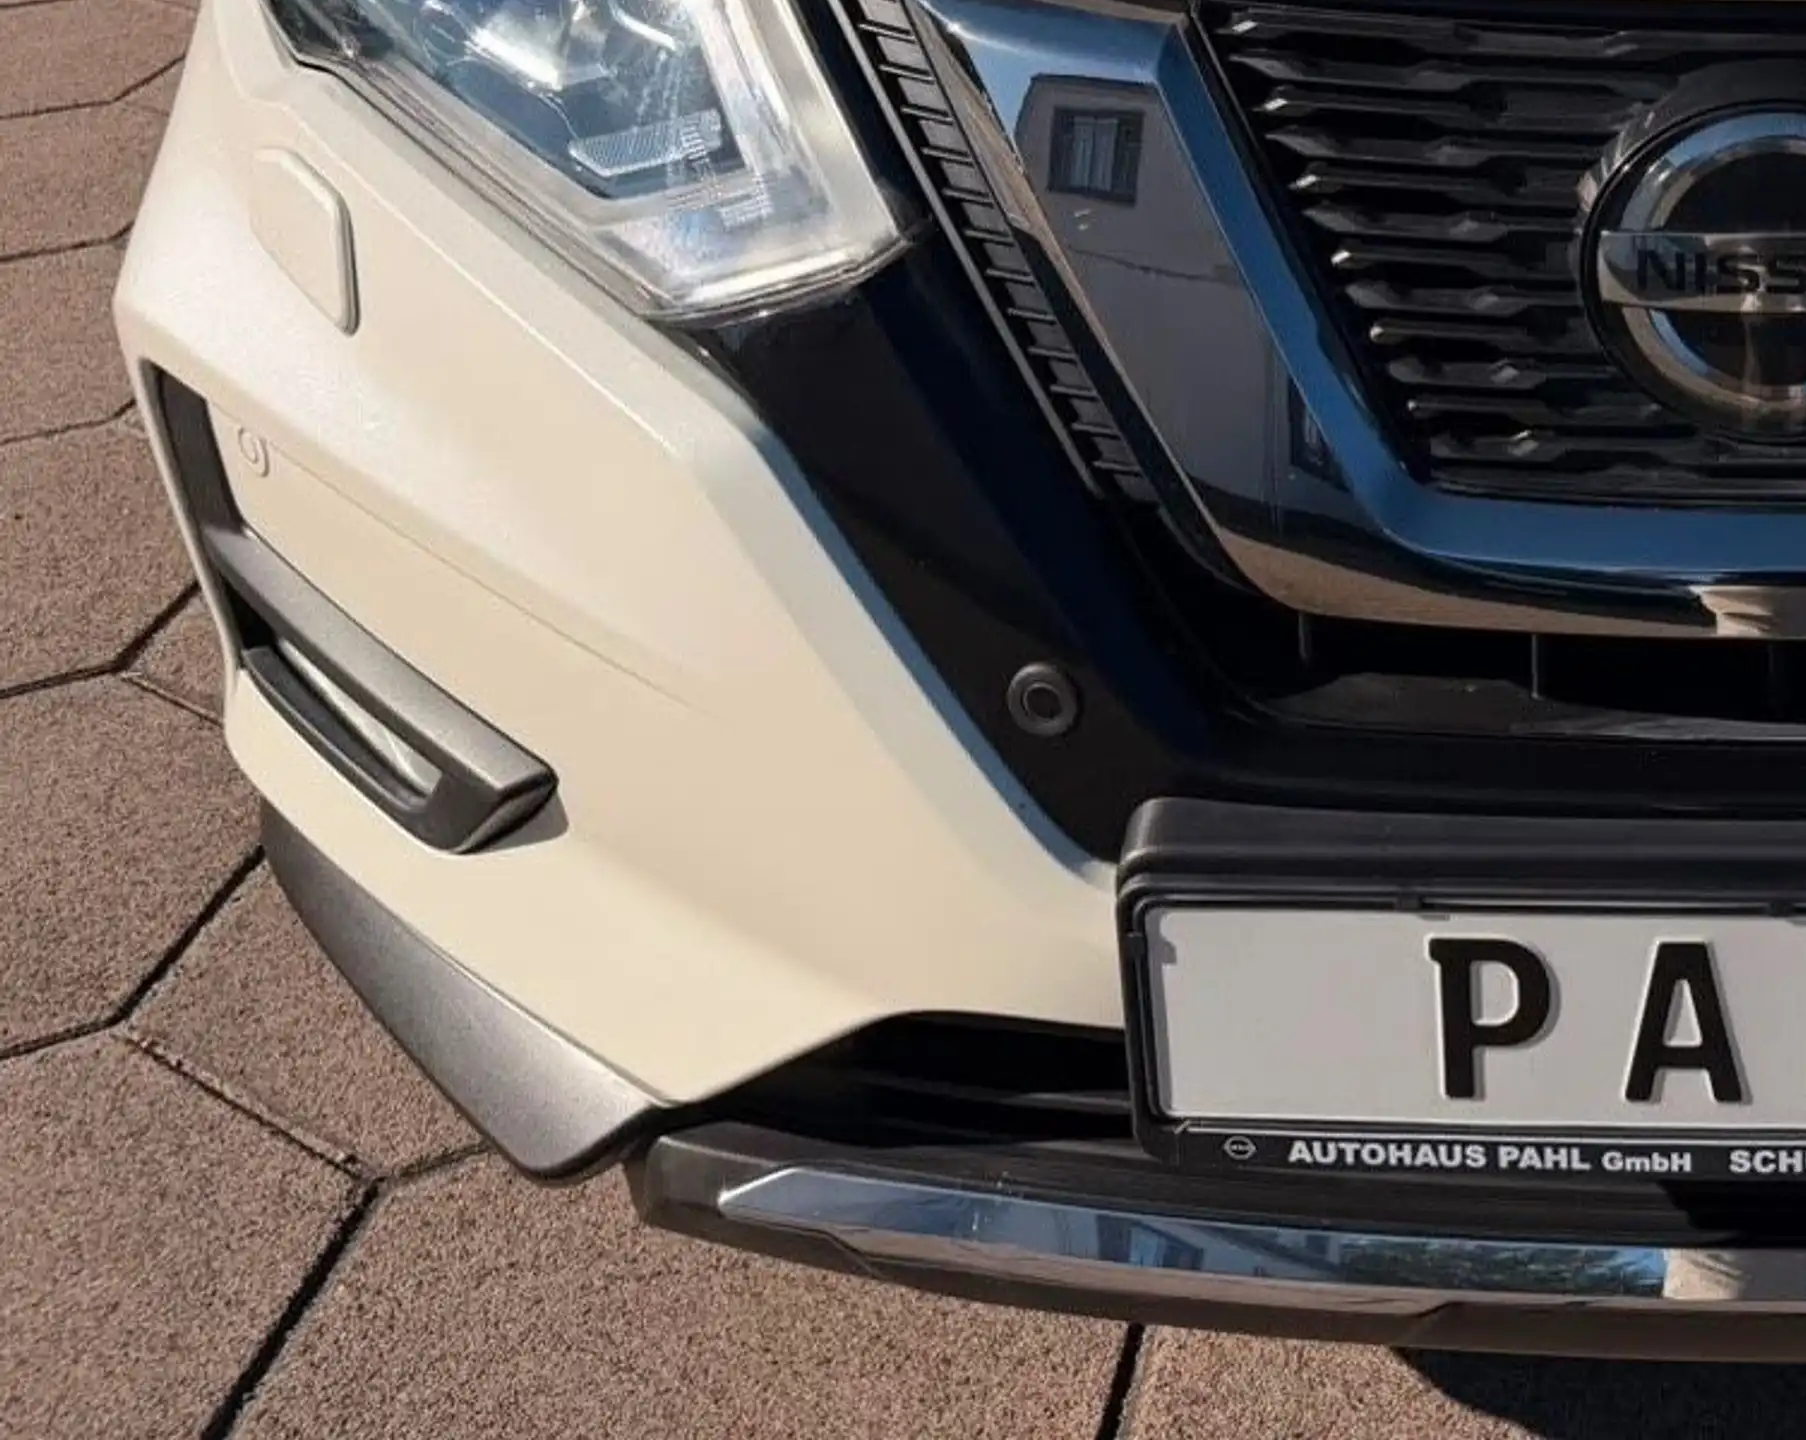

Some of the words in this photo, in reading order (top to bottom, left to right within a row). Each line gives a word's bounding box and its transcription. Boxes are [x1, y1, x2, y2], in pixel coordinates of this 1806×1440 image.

[1287, 1138, 1487, 1169] AUTOHAUS
[1498, 1144, 1593, 1172] PAHL
[1601, 1150, 1693, 1174] GmbH
